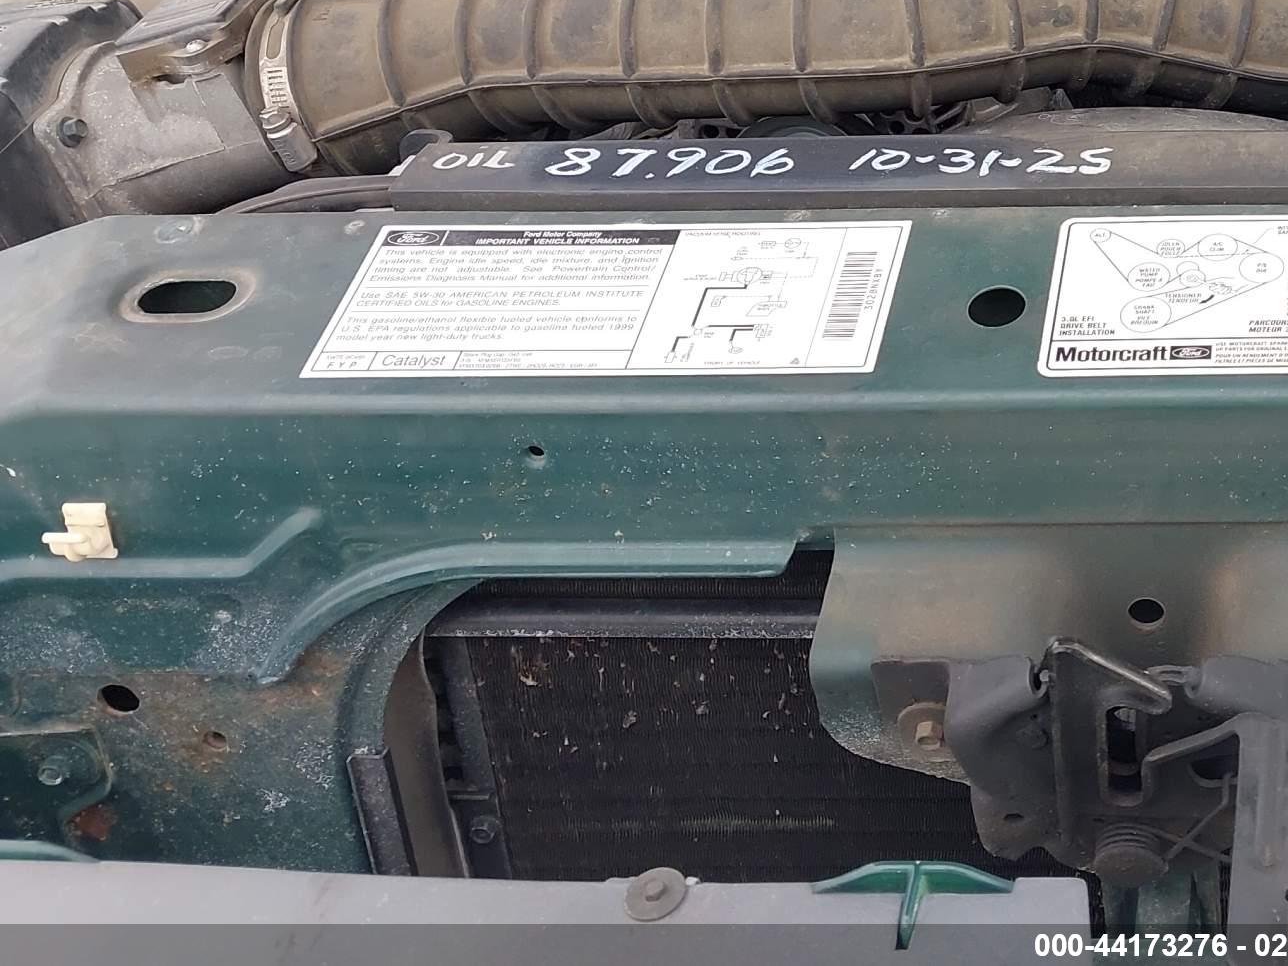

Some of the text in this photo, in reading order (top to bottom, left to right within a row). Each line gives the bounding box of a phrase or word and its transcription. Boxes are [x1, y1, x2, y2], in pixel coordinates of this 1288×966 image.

[545, 147, 794, 179] 87.906
[566, 231, 602, 239] Company
[461, 249, 509, 258] equipped
[512, 248, 532, 256] with
[588, 248, 624, 257] engine
[429, 258, 464, 266] Engine
[468, 257, 486, 265] idle
[530, 257, 548, 265] idle
[621, 256, 659, 264] ignition
[374, 266, 406, 275] timing
[426, 275, 476, 283] Diagnosis
[393, 325, 450, 334] regulations
[454, 324, 507, 333] applicable
[524, 324, 568, 333] gasoline
[370, 334, 394, 343] year
[420, 334, 468, 343] light-duty
[1055, 346, 1168, 362] Motorcraft
[382, 354, 446, 367] Catalyst
